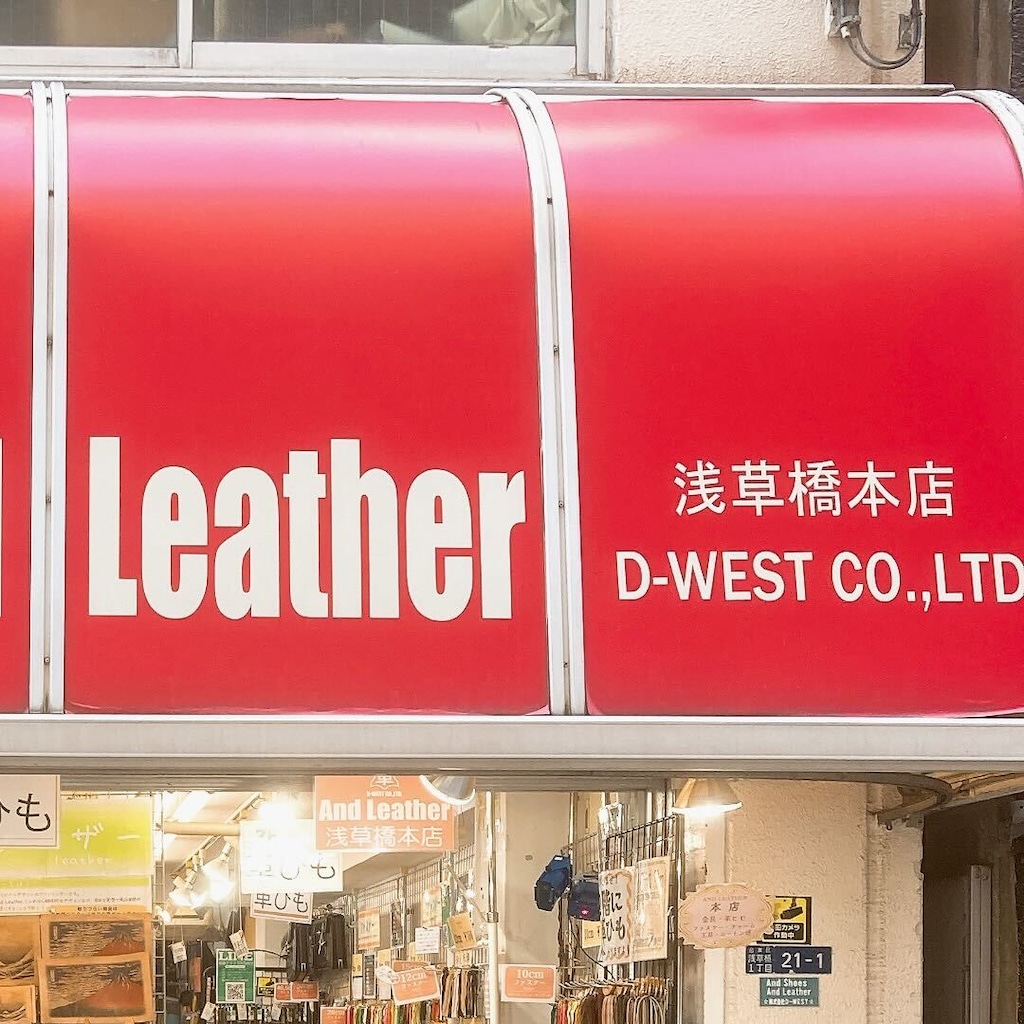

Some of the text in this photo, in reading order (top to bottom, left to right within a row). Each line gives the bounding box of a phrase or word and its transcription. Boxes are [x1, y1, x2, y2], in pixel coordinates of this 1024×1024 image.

[674, 460, 955, 518] 浅草橋本店
[88, 436, 526, 621] Leather
[616, 550, 1024, 613] D-WEST CO.,LTD
[319, 799, 451, 821] And Leather
[326, 826, 444, 848] 浅草橋本店
[710, 902, 740, 912] 本店
[747, 954, 772, 963] 浅草橋
[781, 952, 824, 969] 21-1
[515, 969, 545, 979] 10cm
[766, 978, 808, 987] And Shoes
[766, 987, 812, 996] And Leather
